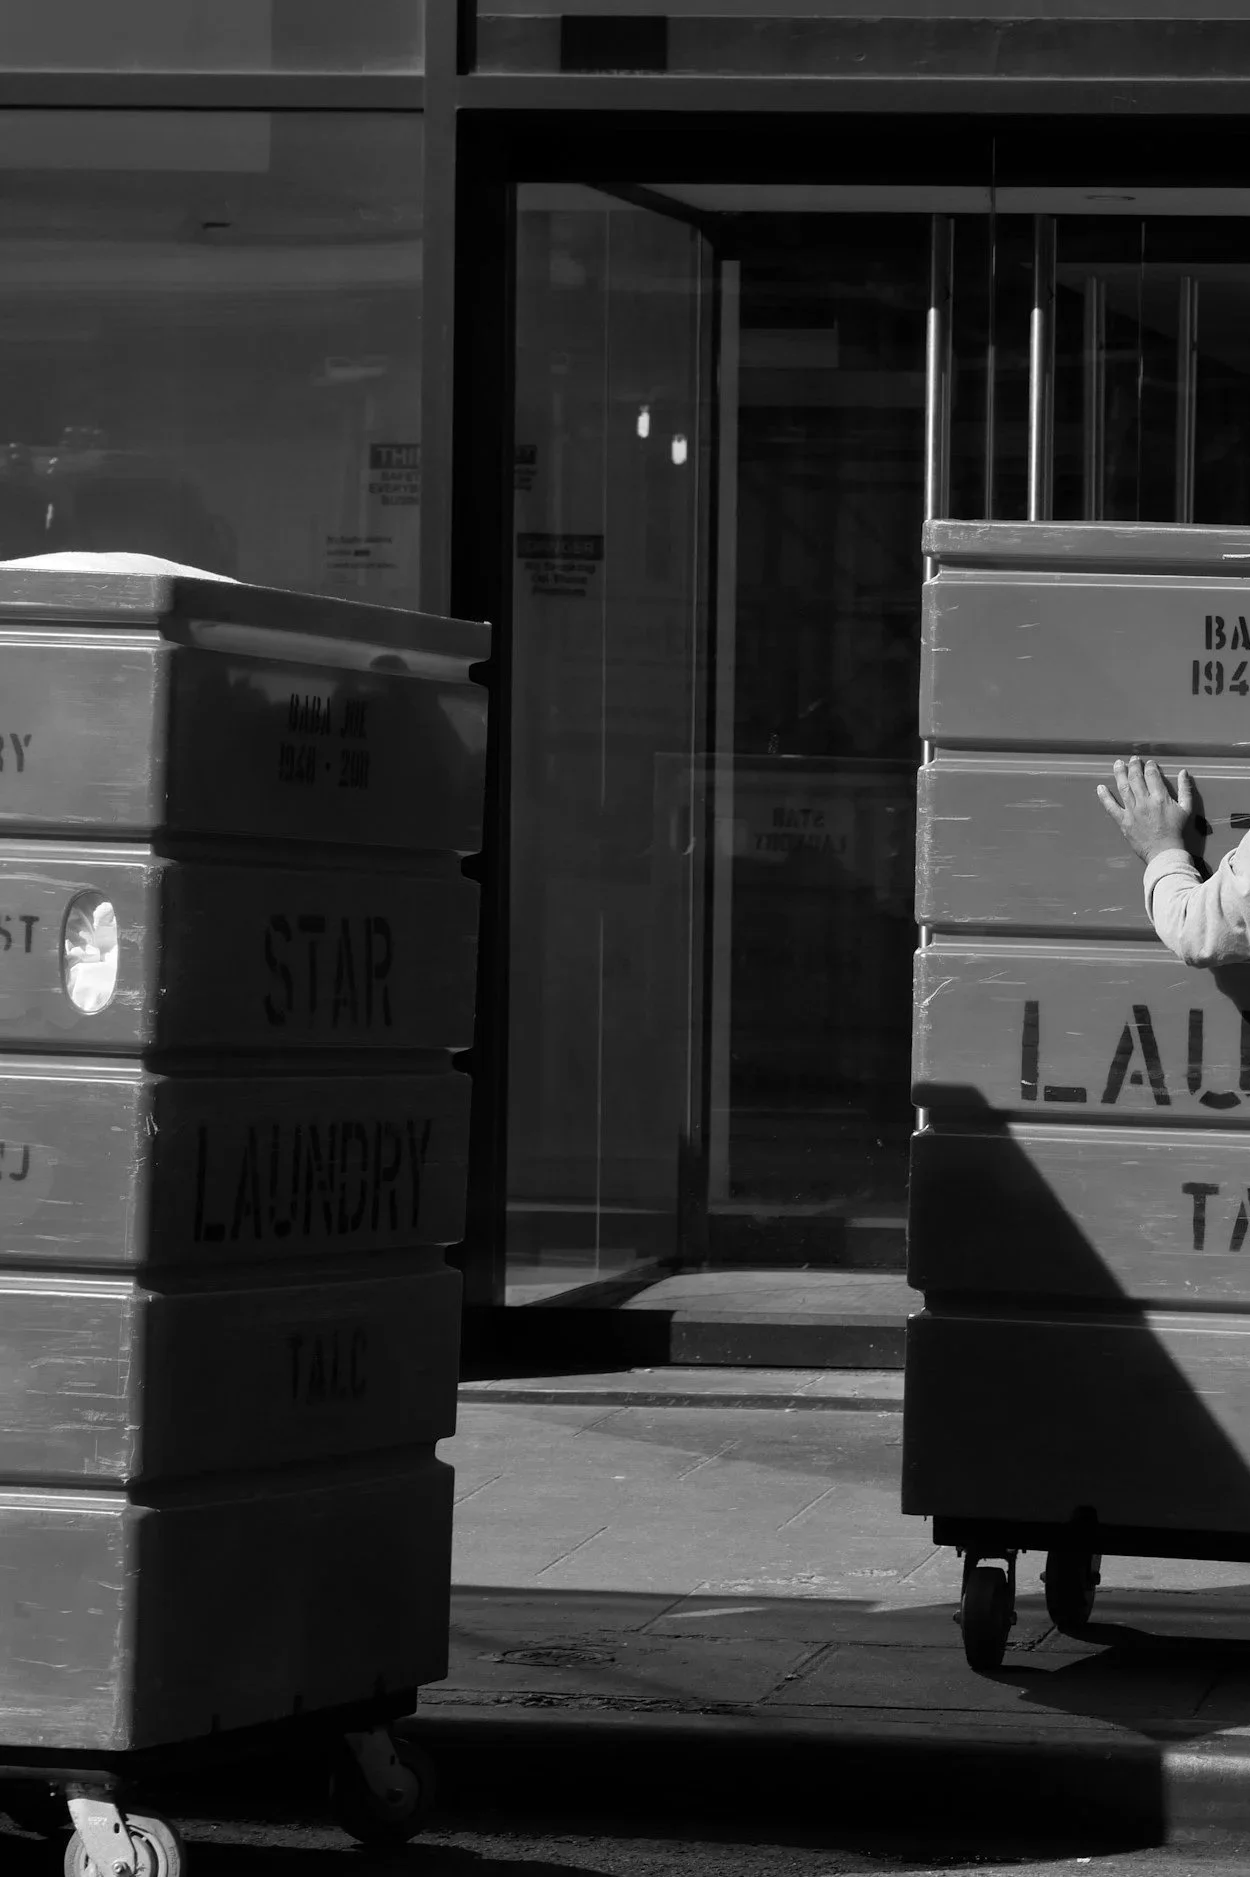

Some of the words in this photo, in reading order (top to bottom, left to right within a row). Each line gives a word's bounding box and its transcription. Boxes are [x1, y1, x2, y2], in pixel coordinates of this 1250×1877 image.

[288, 693, 331, 736] BABA
[340, 700, 368, 740] JOE
[278, 742, 317, 785] 1948
[338, 748, 370, 789] 2011
[264, 913, 393, 1028] STAR
[194, 1118, 431, 1243] LAUNDRY
[286, 1327, 367, 1404] TALC
